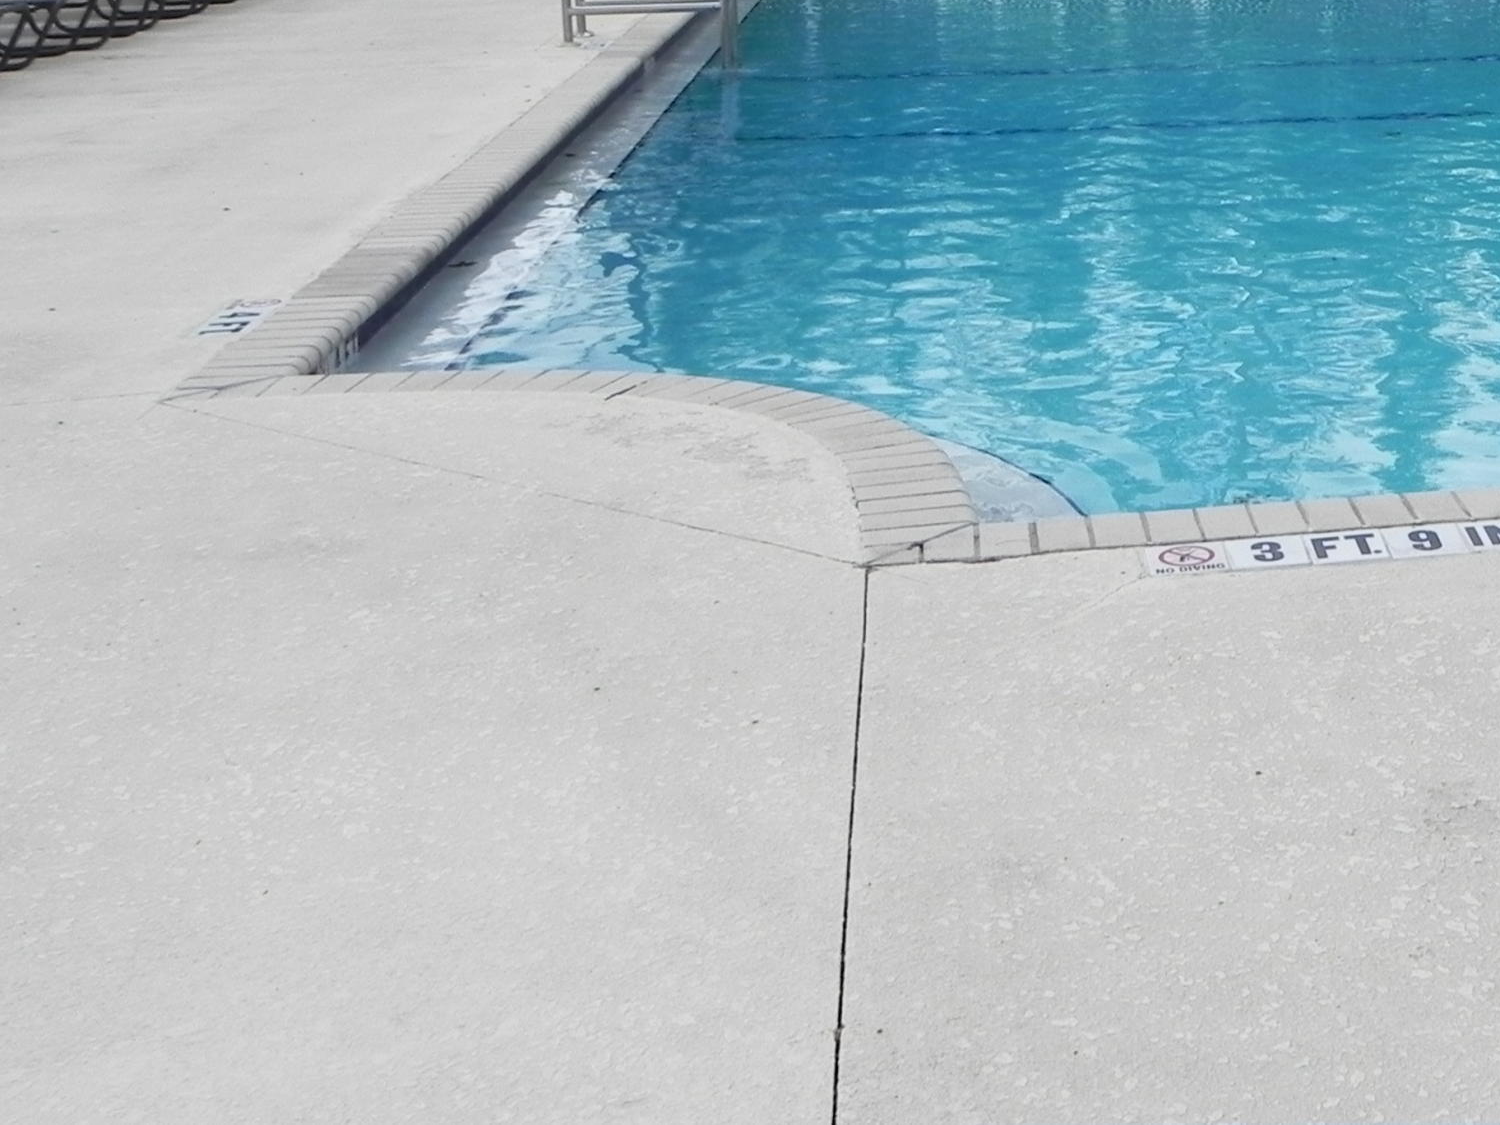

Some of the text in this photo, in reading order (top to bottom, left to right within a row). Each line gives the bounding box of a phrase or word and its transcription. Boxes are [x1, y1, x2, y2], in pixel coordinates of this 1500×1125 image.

[1250, 541, 1285, 562] 3
[1310, 533, 1383, 559] FT.
[1407, 530, 1443, 551] 9
[1179, 562, 1226, 573] DIVING
